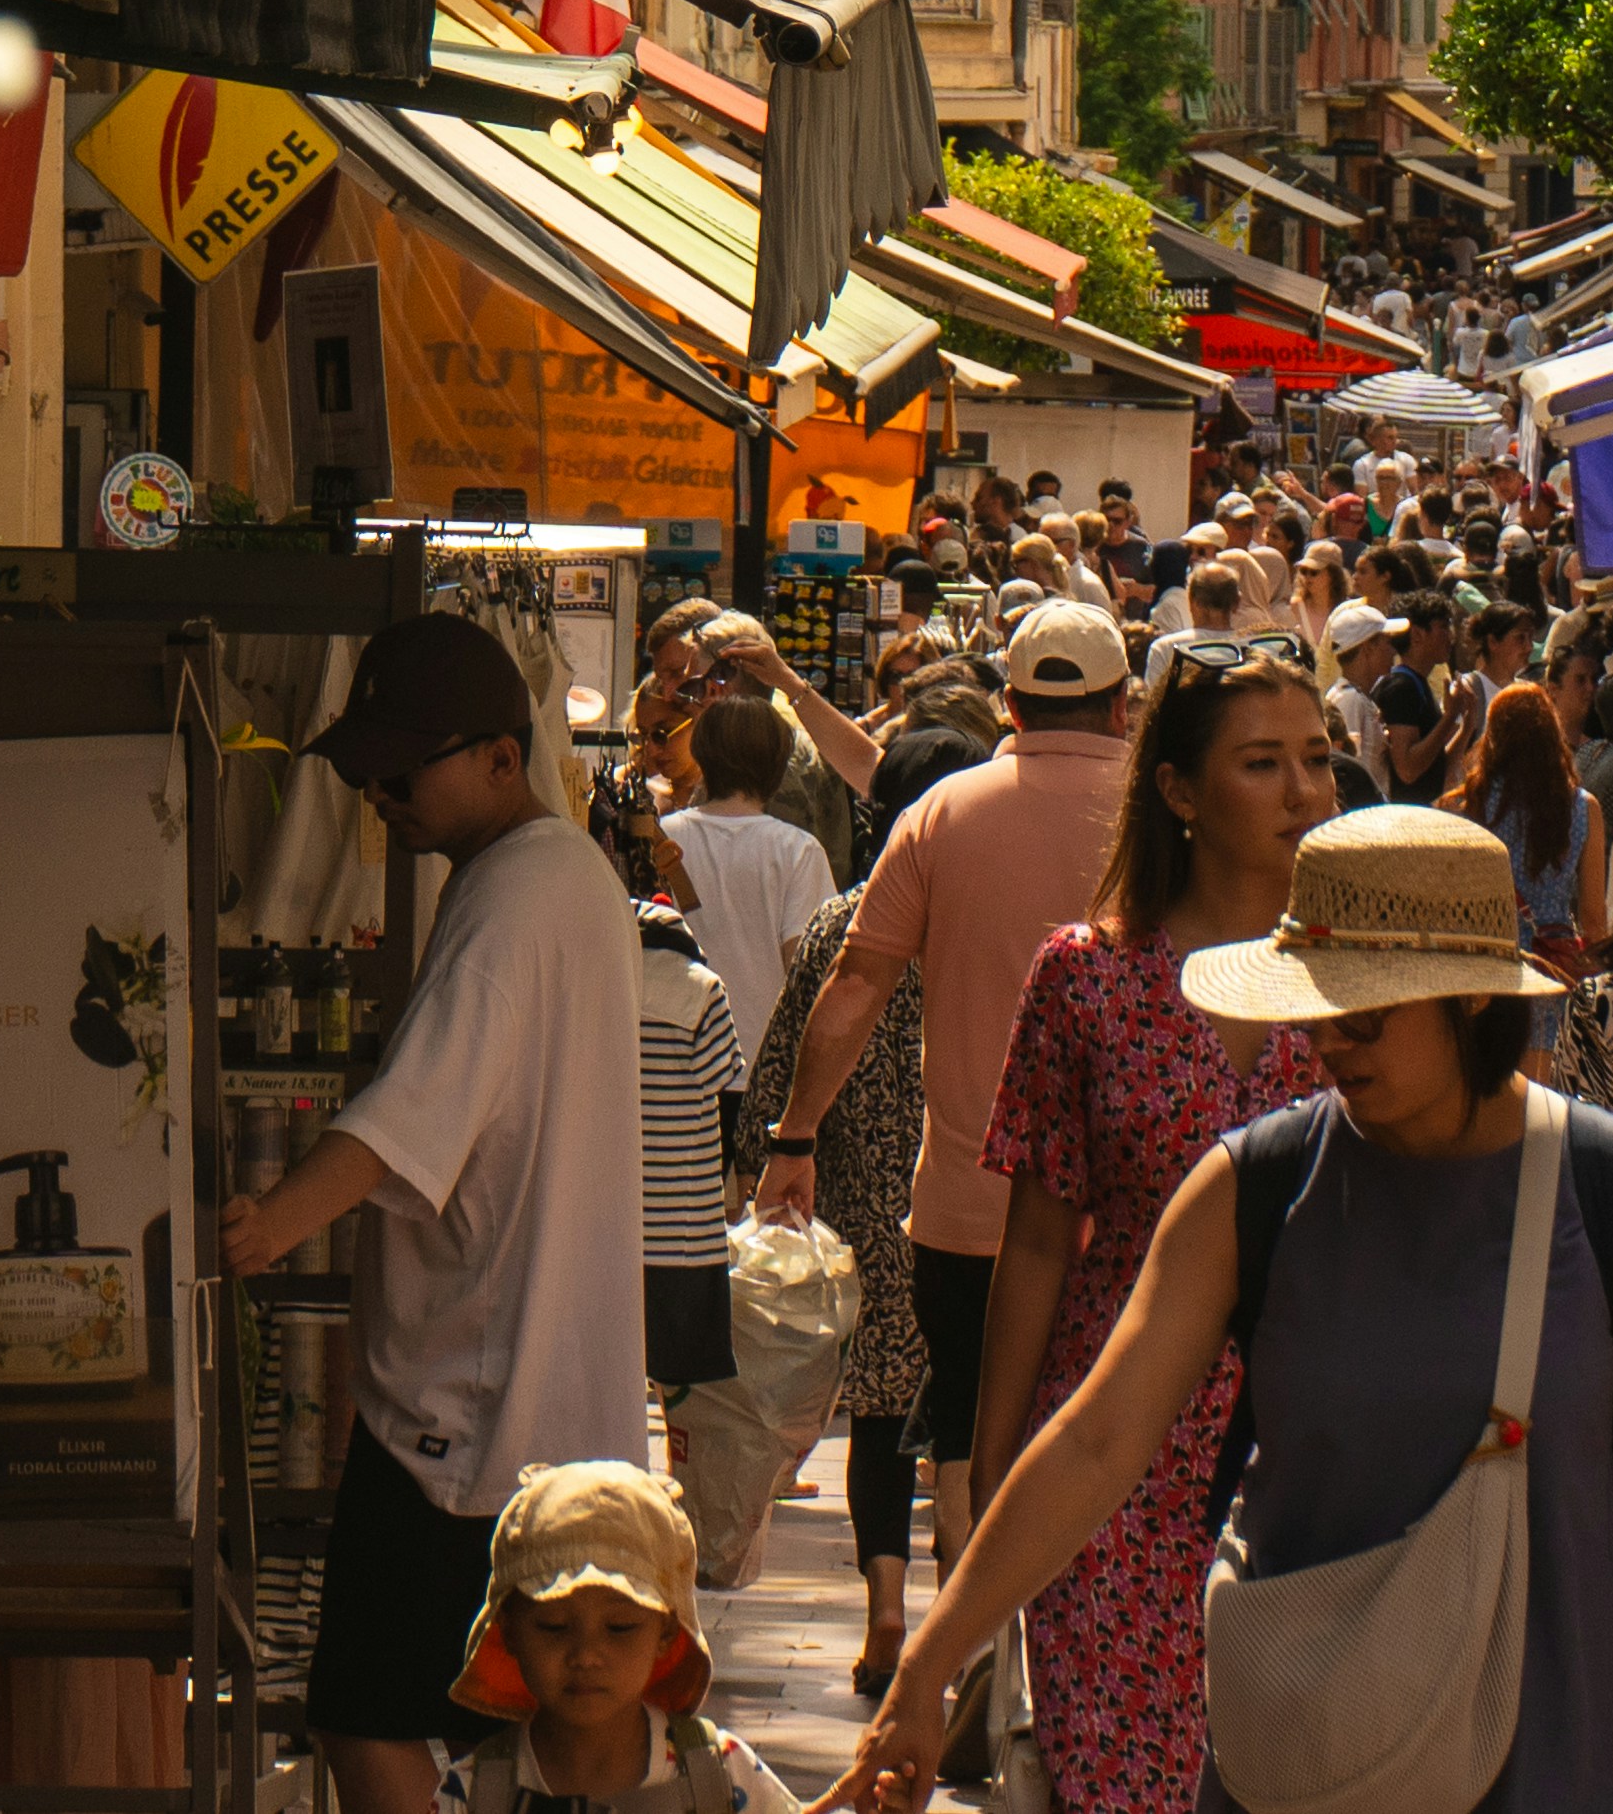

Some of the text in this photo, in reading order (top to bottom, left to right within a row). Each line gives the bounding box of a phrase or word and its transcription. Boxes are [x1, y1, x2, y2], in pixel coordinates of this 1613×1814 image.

[184, 128, 320, 266] PRESSE
[225, 1075, 235, 1089] &
[240, 1075, 287, 1090] Nature
[56, 1435, 107, 1455] ÉLIXIR
[7, 1456, 157, 1475] FLORAL GOURMAND
